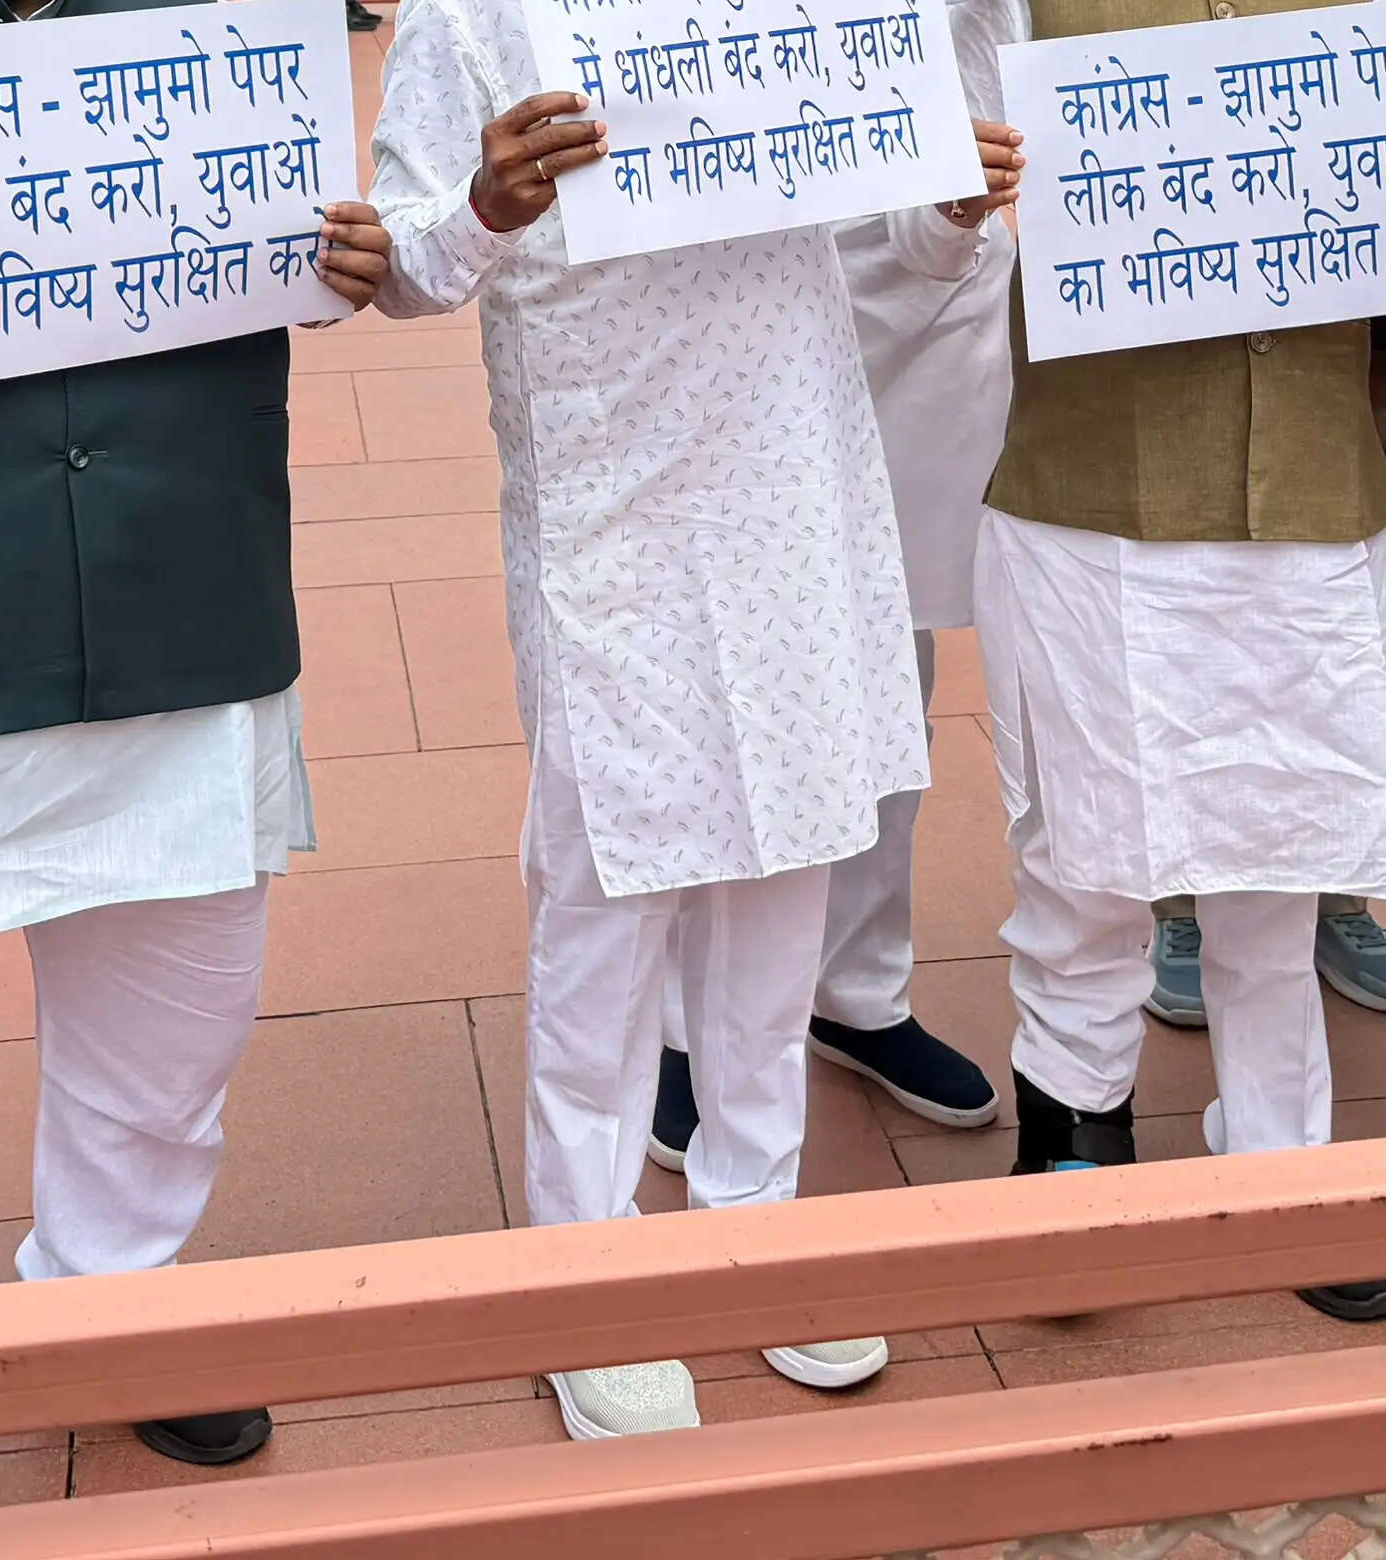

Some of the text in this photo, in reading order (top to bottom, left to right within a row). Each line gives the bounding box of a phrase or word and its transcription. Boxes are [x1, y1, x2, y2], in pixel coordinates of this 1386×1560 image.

[42, 101, 60, 112] -
[73, 30, 211, 141] झामुमो
[223, 25, 308, 108] पेपर
[572, 33, 605, 109] में
[615, 17, 713, 104] धांधली
[718, 20, 765, 89] बंद
[768, 4, 830, 87] करो,
[1055, 56, 1170, 139] कांग्रेस
[1187, 96, 1203, 105] -
[1214, 31, 1339, 132] झामुमो
[5, 155, 72, 235] बंद
[85, 134, 177, 227] करो,
[193, 114, 321, 230] युवाओं
[609, 87, 919, 205] का भविष्य सुरक्षित करो
[1058, 149, 1146, 227] लीक
[1157, 144, 1216, 215] बंद
[1226, 125, 1309, 210] करो,
[110, 225, 254, 333] सुरक्षित
[266, 206, 329, 287] कर
[1053, 259, 1106, 316] का
[1122, 228, 1240, 306] भविष्य
[1251, 208, 1380, 307] सुरक्षित
